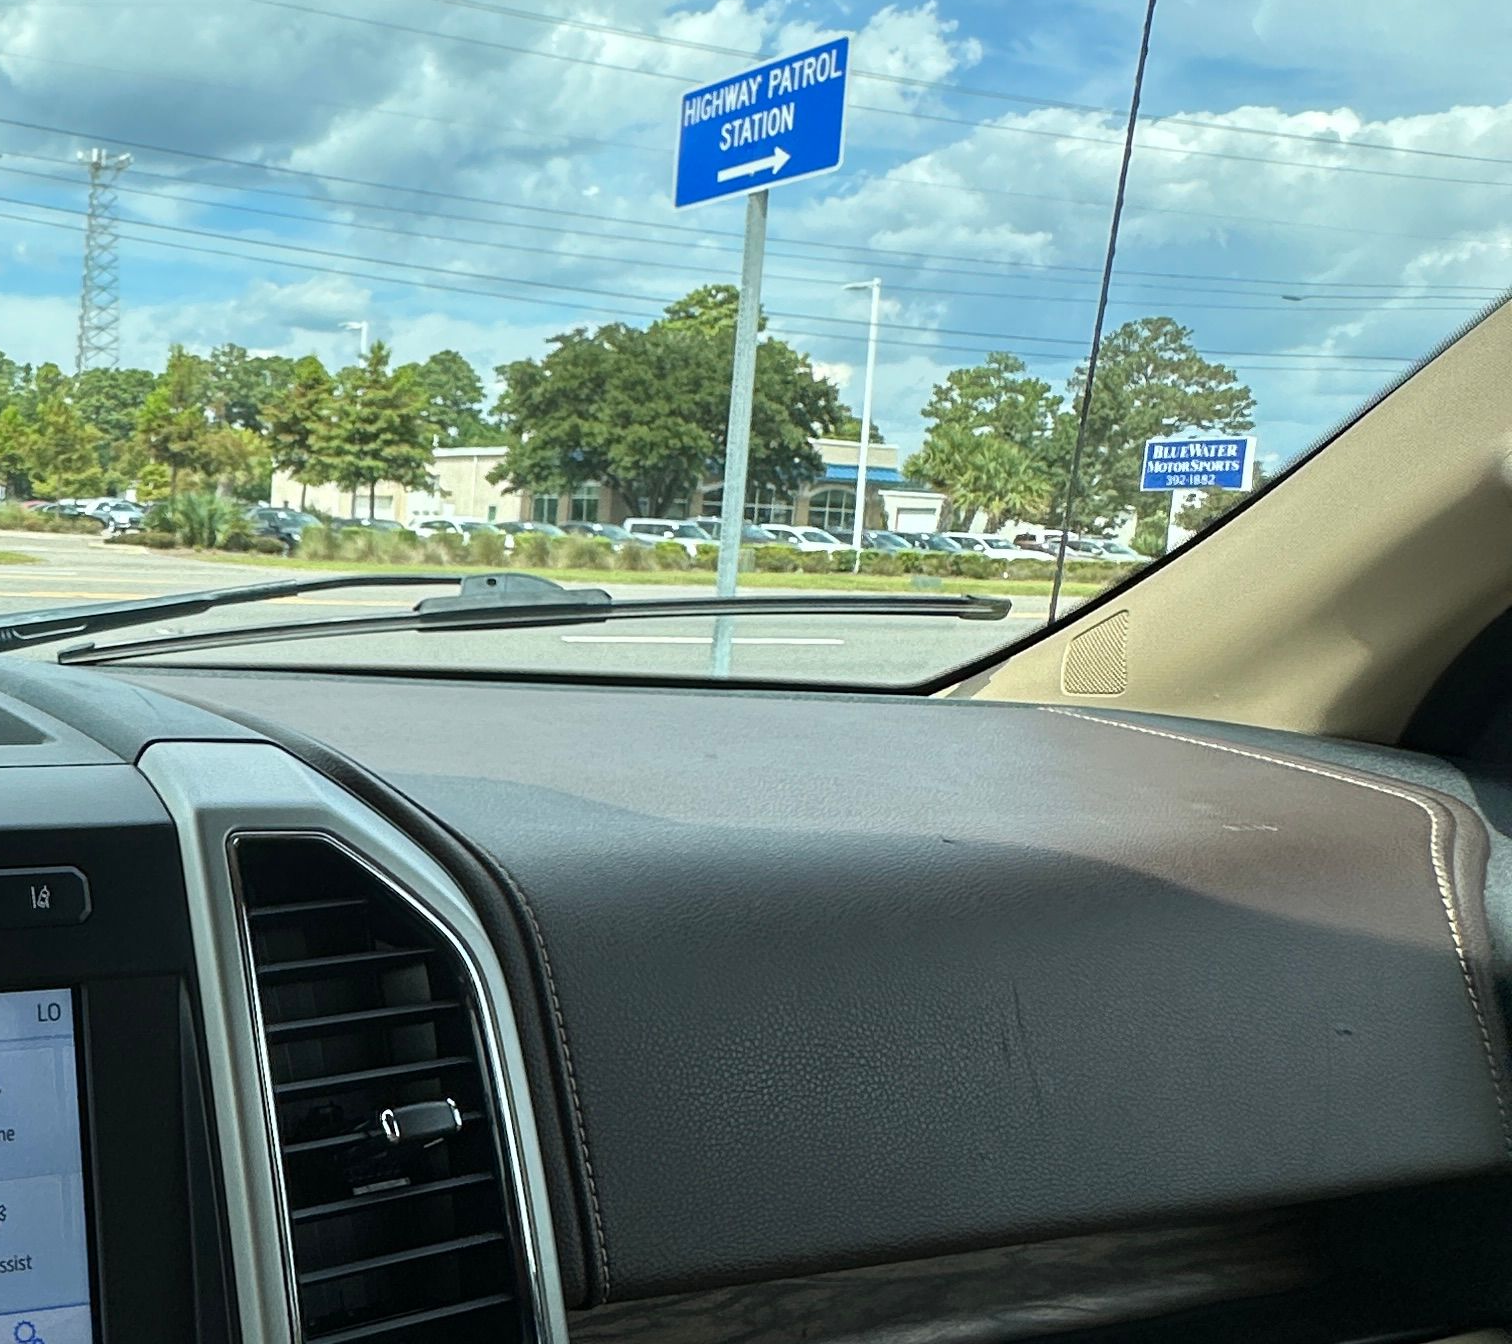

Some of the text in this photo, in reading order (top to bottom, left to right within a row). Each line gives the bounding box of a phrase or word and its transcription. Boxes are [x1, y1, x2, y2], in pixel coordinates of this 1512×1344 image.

[684, 49, 843, 127] HIGHWAY PATROL
[719, 102, 795, 151] STATION
[37, 1002, 62, 1023] LO
